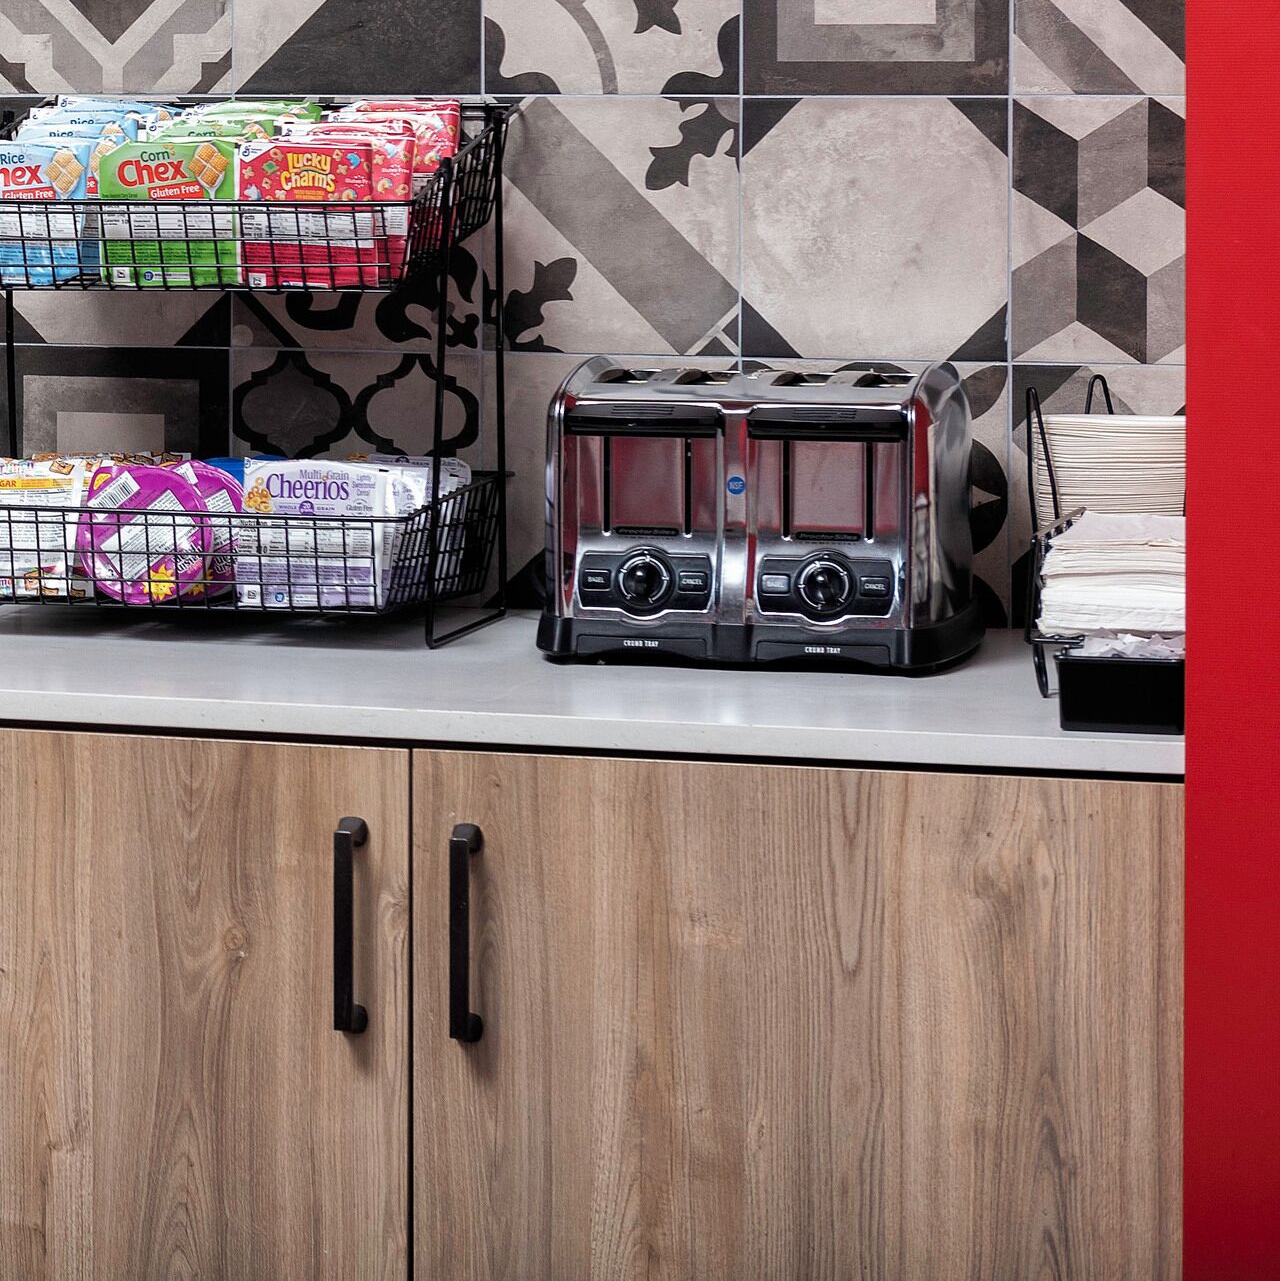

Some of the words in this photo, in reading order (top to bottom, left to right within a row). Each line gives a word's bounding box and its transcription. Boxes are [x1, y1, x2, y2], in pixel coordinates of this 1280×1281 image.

[0, 153, 25, 165] Rice
[141, 150, 170, 162] Corn
[287, 153, 331, 173] Lucky
[117, 160, 189, 187] Chex
[280, 171, 335, 192] Charms
[35, 190, 53, 198] Free
[151, 186, 179, 198] Gluten
[181, 185, 200, 194] Free
[300, 469, 322, 480] Multi
[327, 470, 350, 480] Grain
[266, 474, 350, 500] Cheerios
